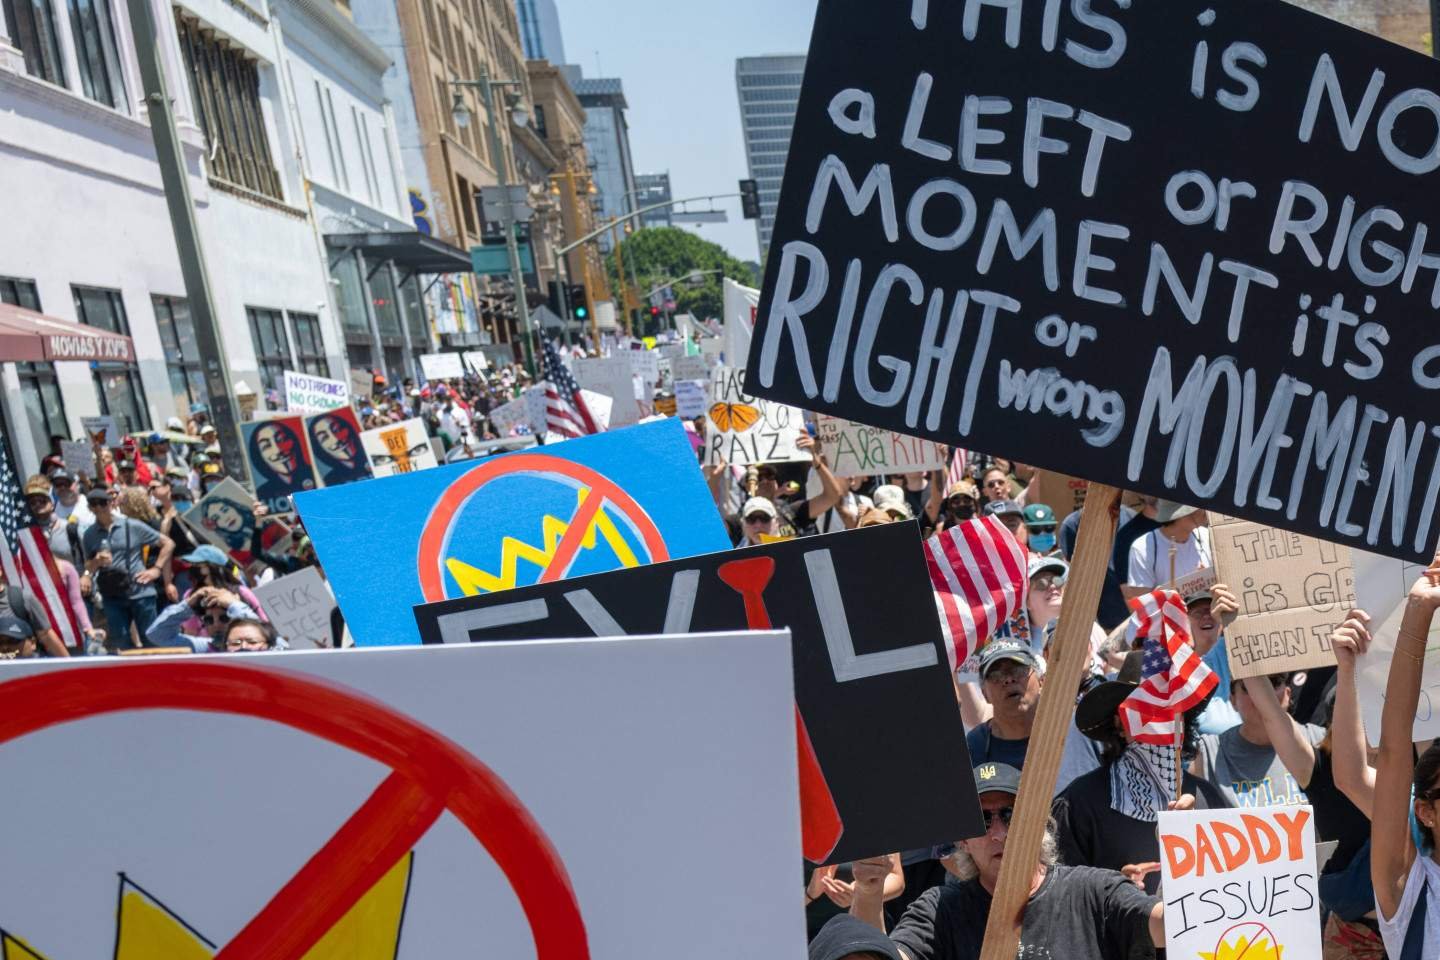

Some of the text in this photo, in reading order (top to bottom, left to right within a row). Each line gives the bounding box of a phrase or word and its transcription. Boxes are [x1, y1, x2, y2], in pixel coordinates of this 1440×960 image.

[1191, 8, 1267, 112] is
[828, 88, 877, 139] a
[901, 71, 1132, 197] LEFT
[1164, 169, 1257, 232] or
[806, 153, 1279, 343] MOMENT
[1292, 293, 1392, 382] it's
[50, 335, 96, 358] NOVIAS
[759, 240, 1022, 437] RIGHT
[1034, 313, 1098, 358] or
[289, 376, 305, 391] NO
[999, 359, 1126, 448] wrong
[386, 433, 406, 450] DEI
[711, 432, 791, 464] RAIZ
[1233, 528, 1302, 564] THE
[267, 584, 321, 616] FUCK
[1243, 576, 1288, 619] is
[282, 609, 329, 640] ICE
[1231, 627, 1308, 667] THAN
[1160, 809, 1311, 880] DADDY
[1167, 873, 1314, 939] ISSUES
